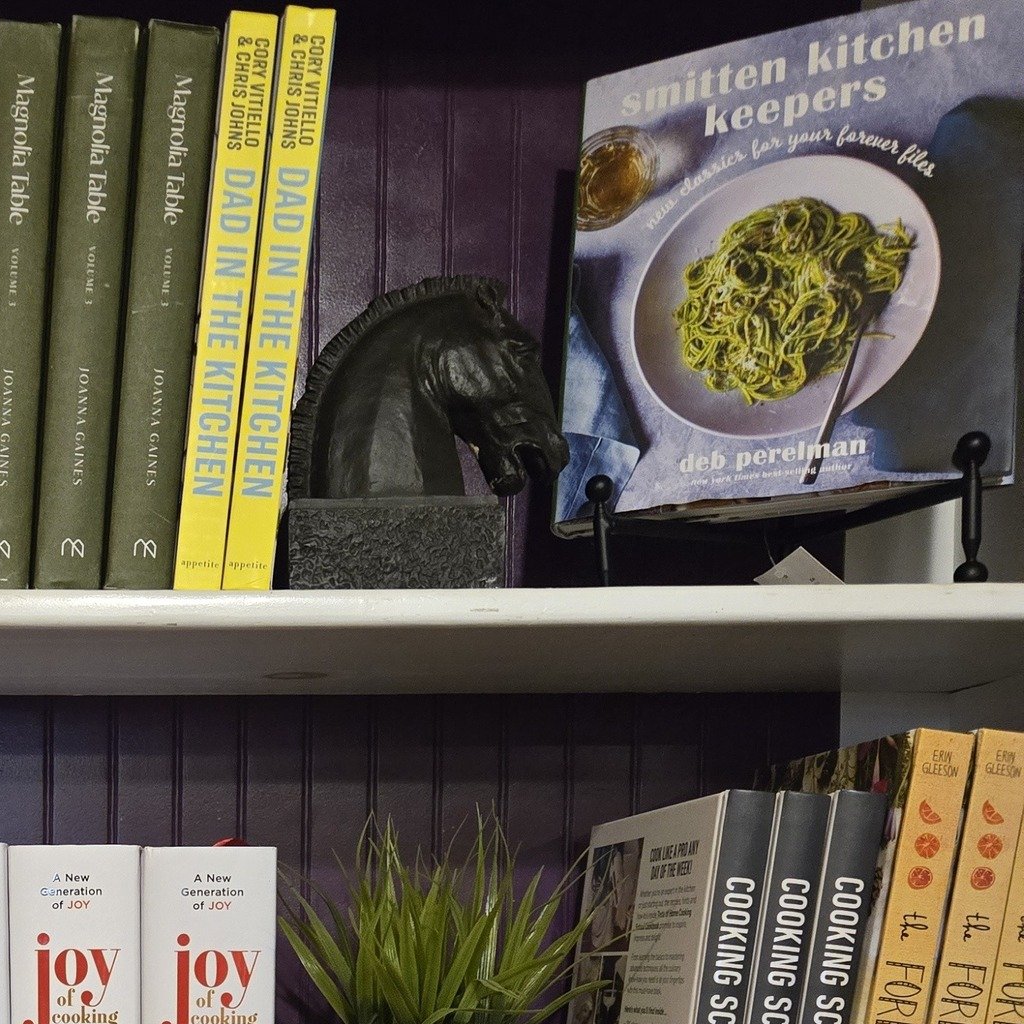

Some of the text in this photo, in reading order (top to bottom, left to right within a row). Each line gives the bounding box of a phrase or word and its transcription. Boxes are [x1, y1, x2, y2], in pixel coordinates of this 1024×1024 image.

[620, 12, 987, 118] smitten kitchen
[227, 36, 253, 151] & CHRIS JOHNS
[244, 37, 270, 148] CORY VITIELLO
[704, 72, 888, 138] keepers
[8, 73, 35, 226] Magnolia Table
[752, 125, 935, 179] for your forever files
[9, 247, 20, 296] VOLUME
[192, 167, 256, 498] DAD IN THE KITCHEN
[1, 368, 14, 427] JOANNA
[679, 436, 868, 474] deb perelman
[180, 559, 220, 570] appetite
[921, 762, 959, 778] GLEESON
[932, 749, 952, 763] ERIN
[40, 886, 103, 897] Generation
[52, 873, 90, 883] A New
[52, 900, 91, 911] of JOY
[899, 911, 929, 942] the
[713, 876, 756, 986] COOKING
[56, 988, 76, 1007] of
